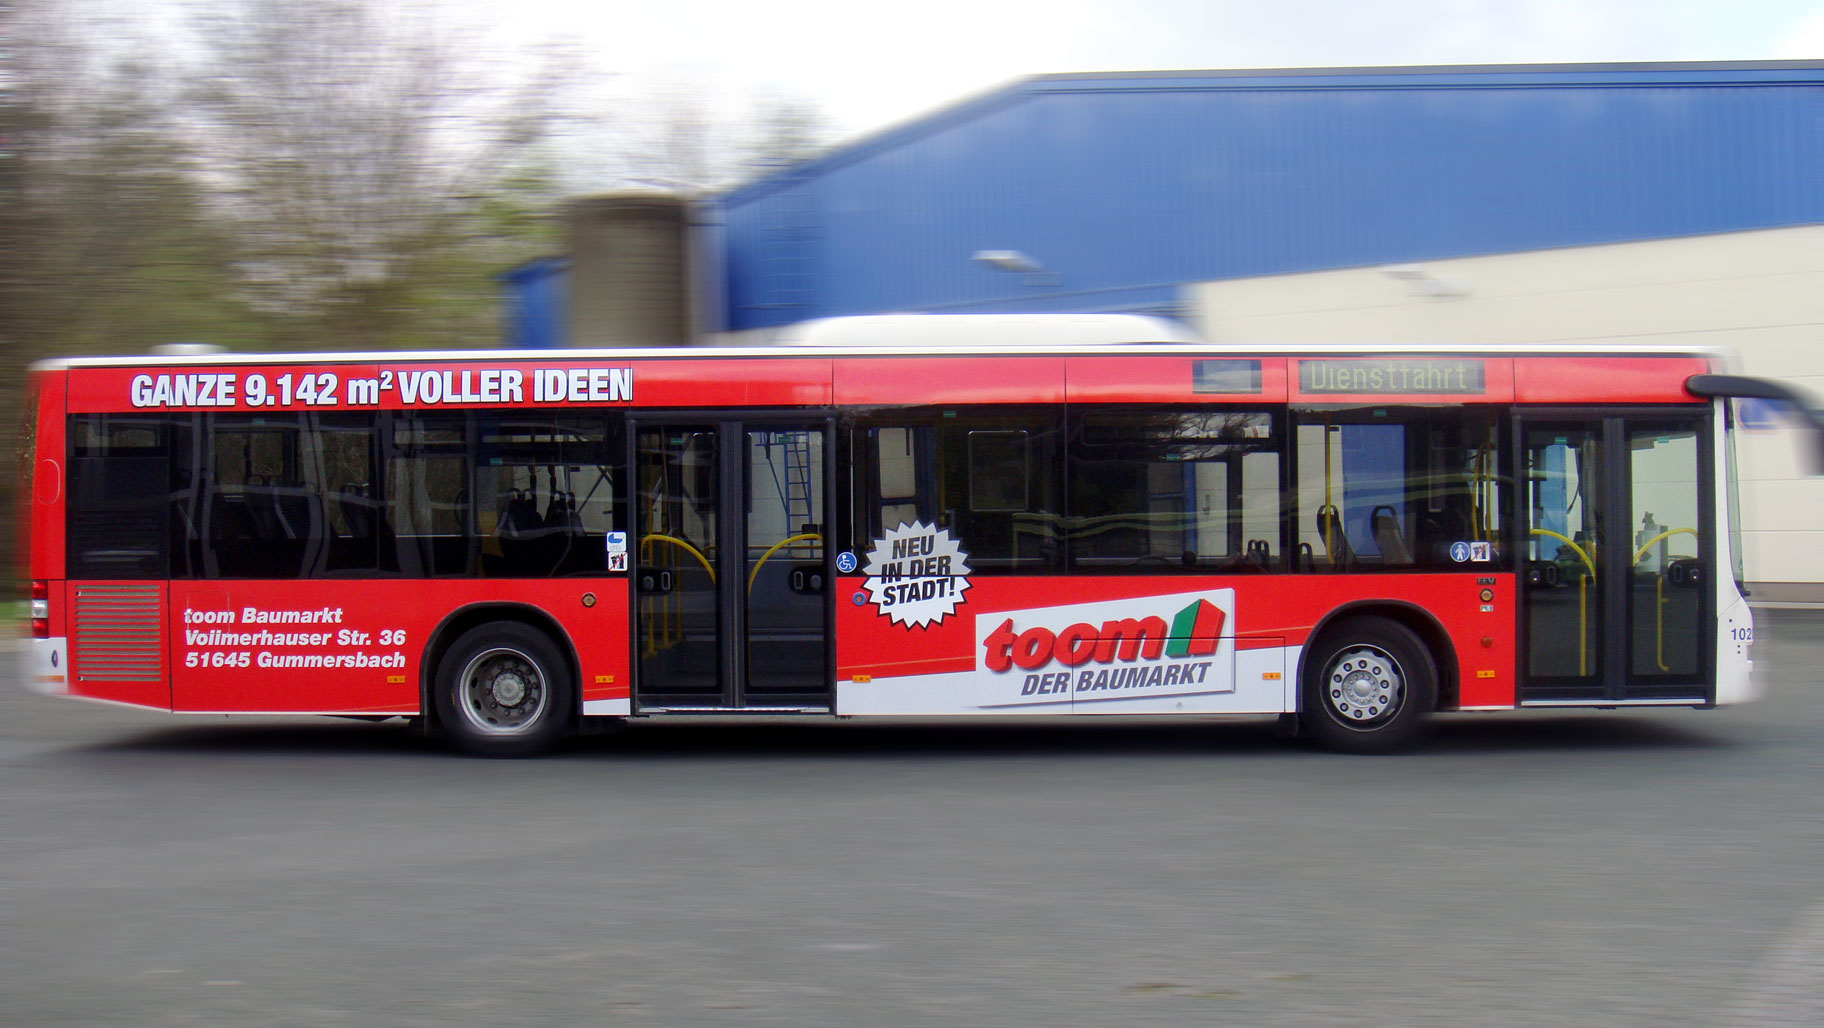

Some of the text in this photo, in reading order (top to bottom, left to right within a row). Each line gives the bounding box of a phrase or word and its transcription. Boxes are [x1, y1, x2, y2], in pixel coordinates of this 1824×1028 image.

[131, 374, 236, 407] GANZE
[245, 373, 338, 406] 9.142
[398, 369, 524, 404] VOLLER
[533, 368, 633, 402] IDEEN
[1311, 361, 1467, 390] Dienstfahrt
[892, 535, 935, 560] NEU
[881, 555, 952, 584] IN DER
[883, 577, 956, 606] STADT!
[184, 607, 344, 624] toom Baumarkt
[337, 629, 372, 646] Str.
[378, 629, 407, 646] 36
[983, 616, 1169, 673] toom
[185, 651, 406, 668] 51645 Gummersbach
[1021, 662, 1212, 696] DER BAUMARKT
